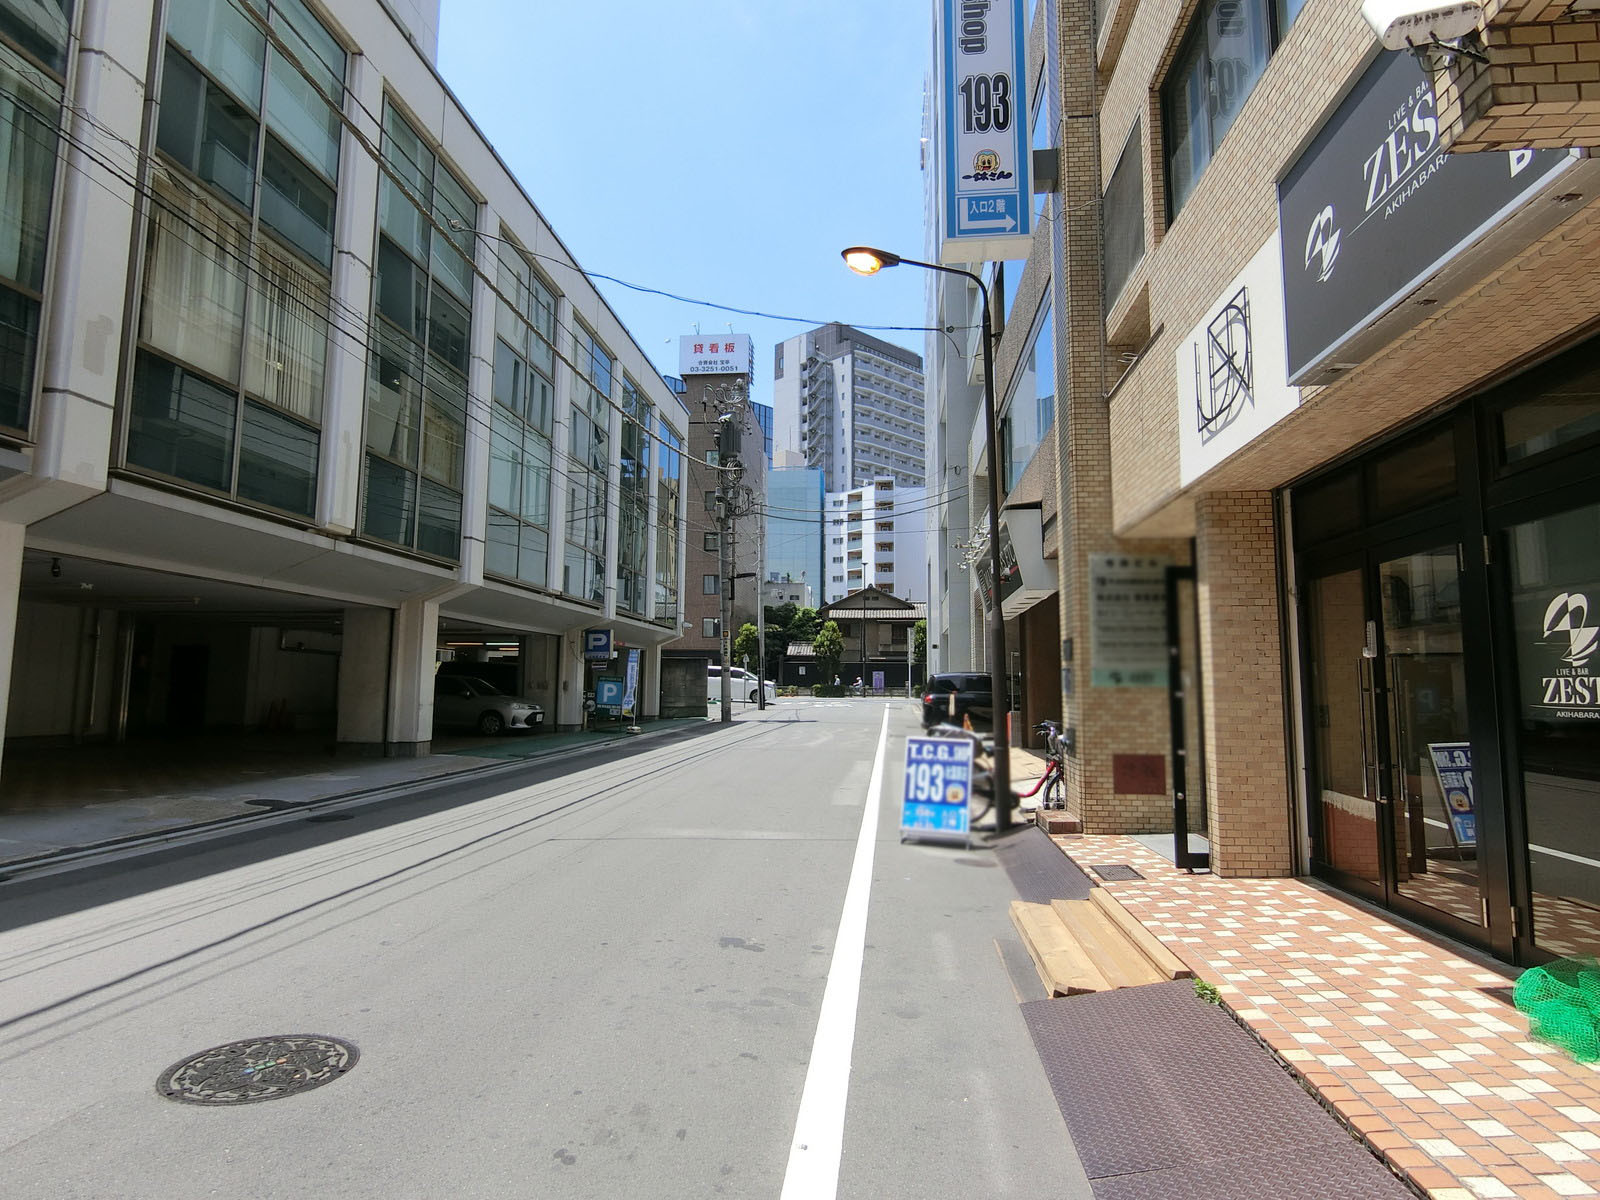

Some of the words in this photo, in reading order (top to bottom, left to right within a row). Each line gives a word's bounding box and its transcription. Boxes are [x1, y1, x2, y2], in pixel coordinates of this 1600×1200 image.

[959, 0, 991, 55] hop
[959, 72, 1012, 134] 193
[1388, 102, 1407, 130] LIVE
[1408, 95, 1414, 108] &
[1416, 80, 1429, 99] BA
[970, 198, 1006, 214] 入口2階
[693, 342, 735, 354] 貸看板
[588, 634, 607, 649] P
[603, 683, 617, 702] P
[907, 763, 944, 802] 193
